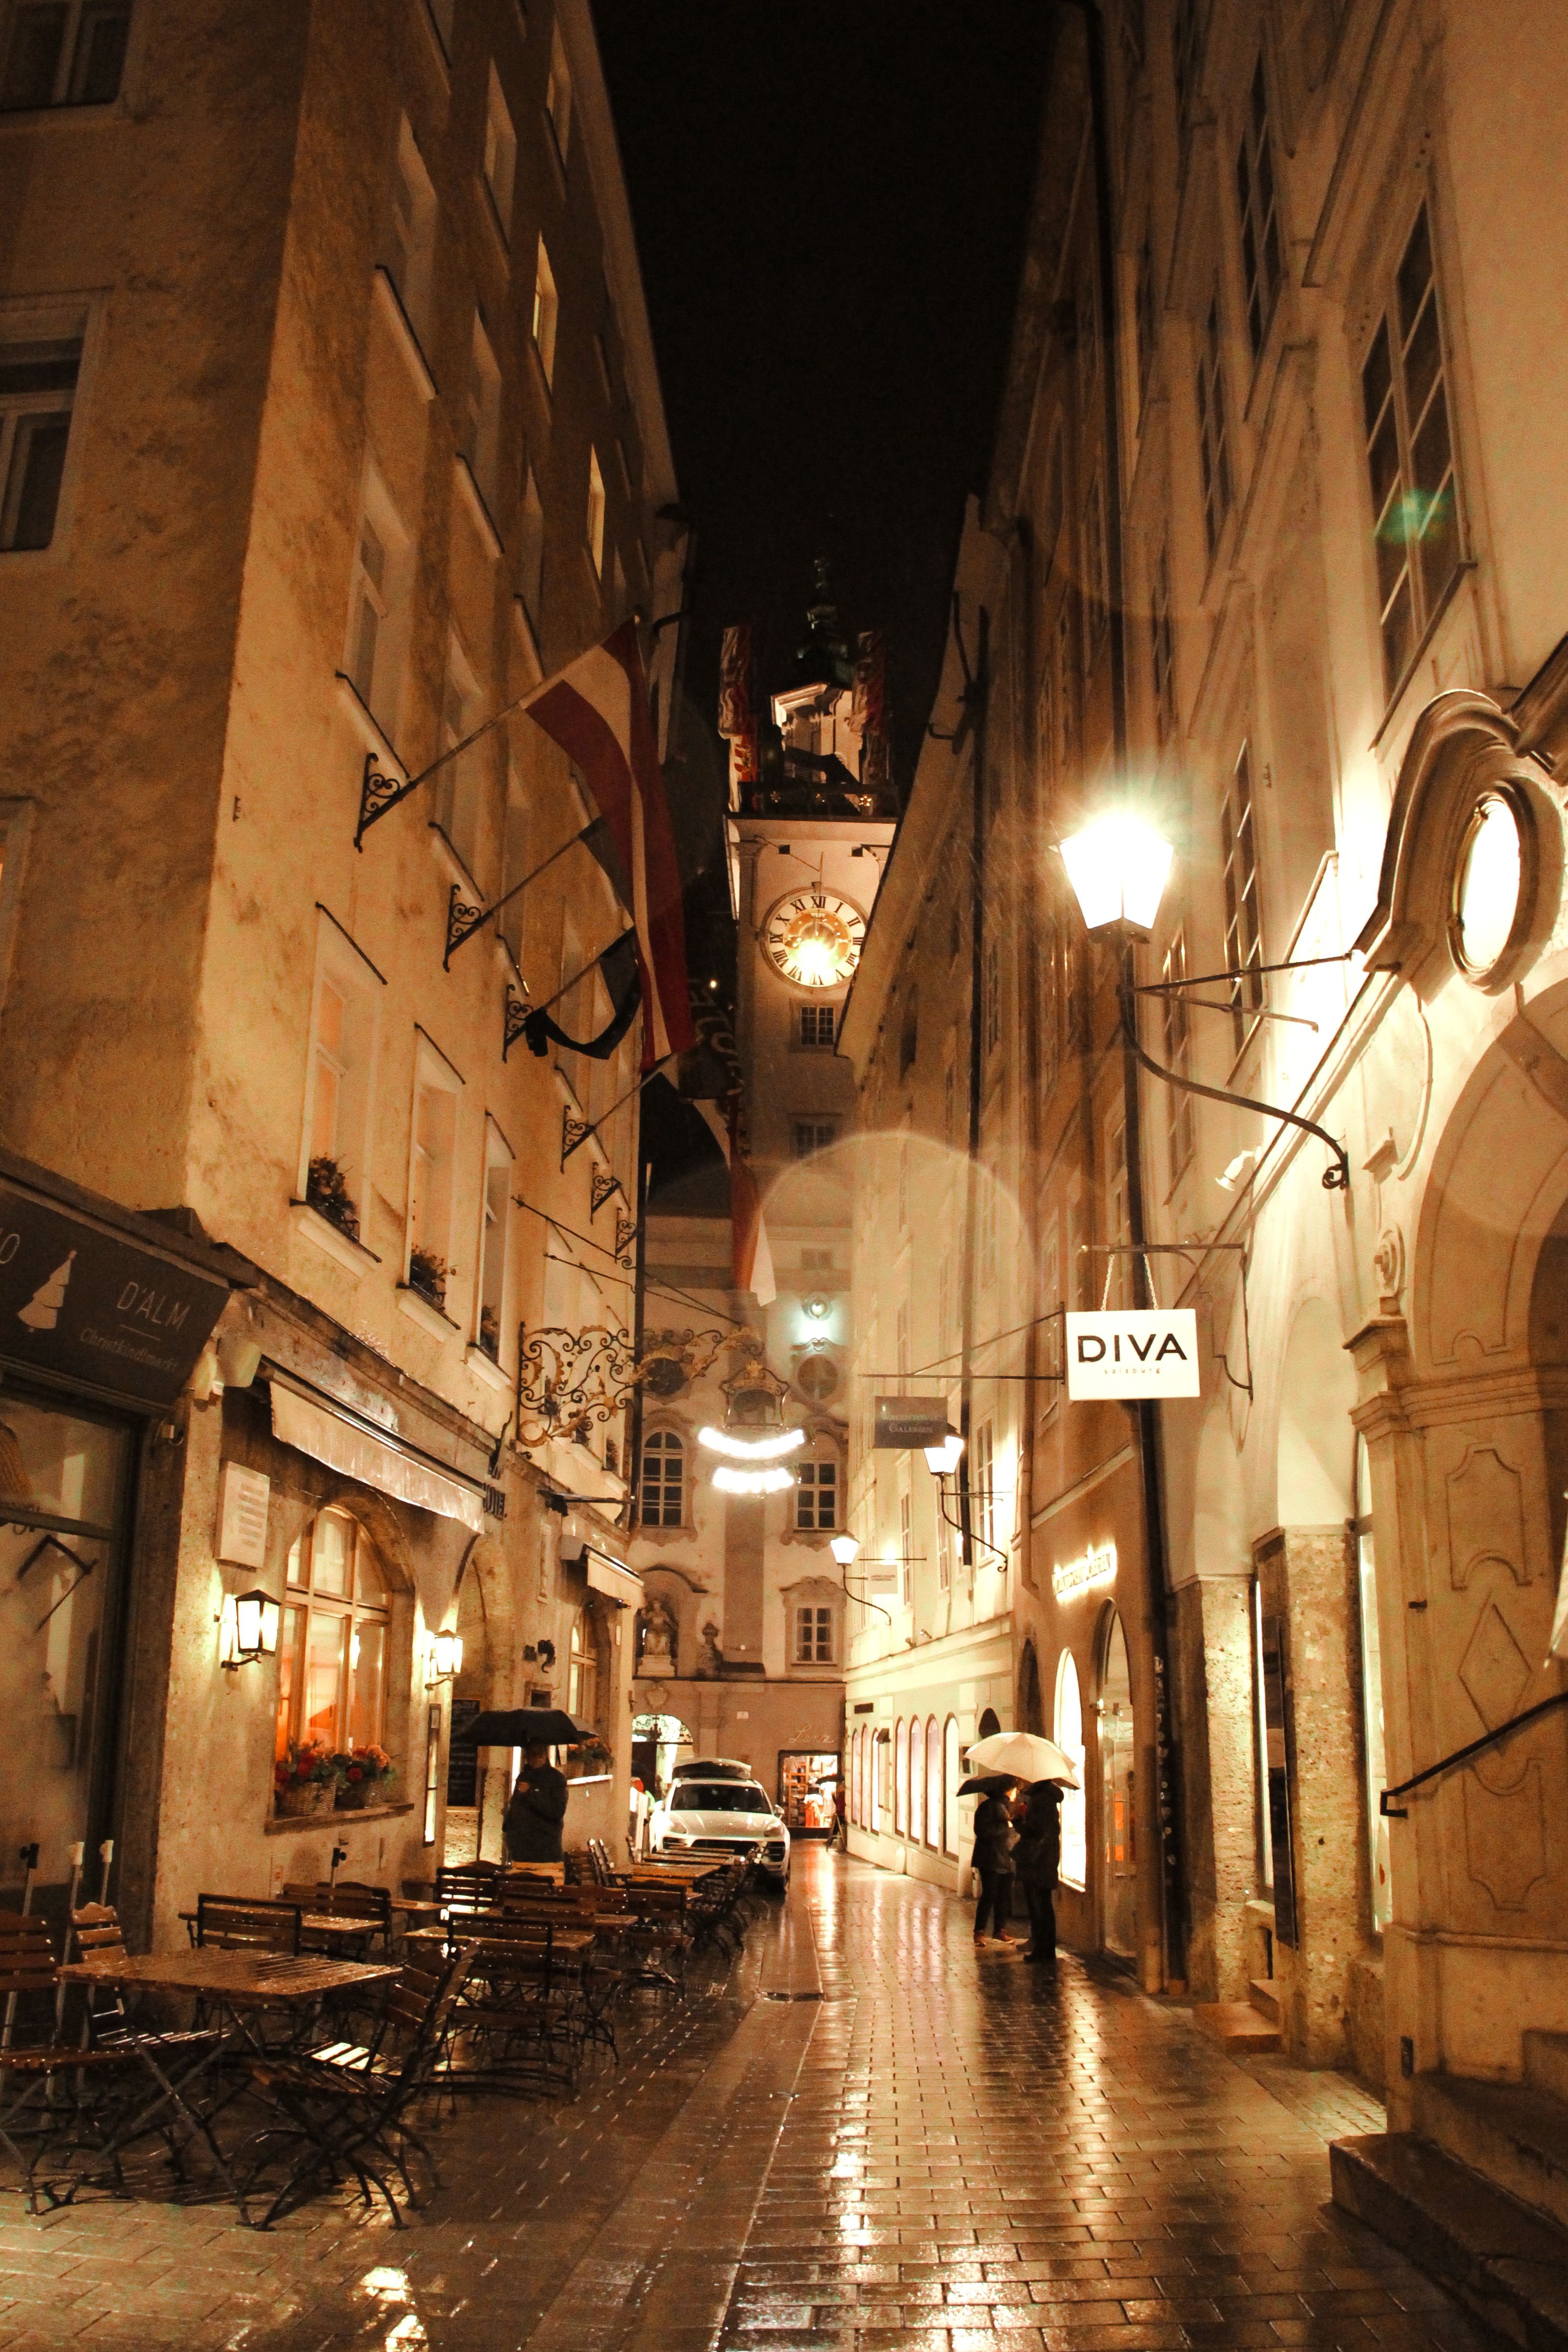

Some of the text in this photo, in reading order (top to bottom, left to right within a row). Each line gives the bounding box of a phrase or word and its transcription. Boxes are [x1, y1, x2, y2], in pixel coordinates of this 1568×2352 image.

[790, 899, 807, 913] XI
[811, 896, 827, 909] XII
[775, 914, 790, 926] X
[847, 916, 862, 927] II
[770, 932, 784, 943] IX
[852, 937, 864, 946] III
[835, 969, 847, 982] V
[1077, 1333, 1188, 1363] DIVA
